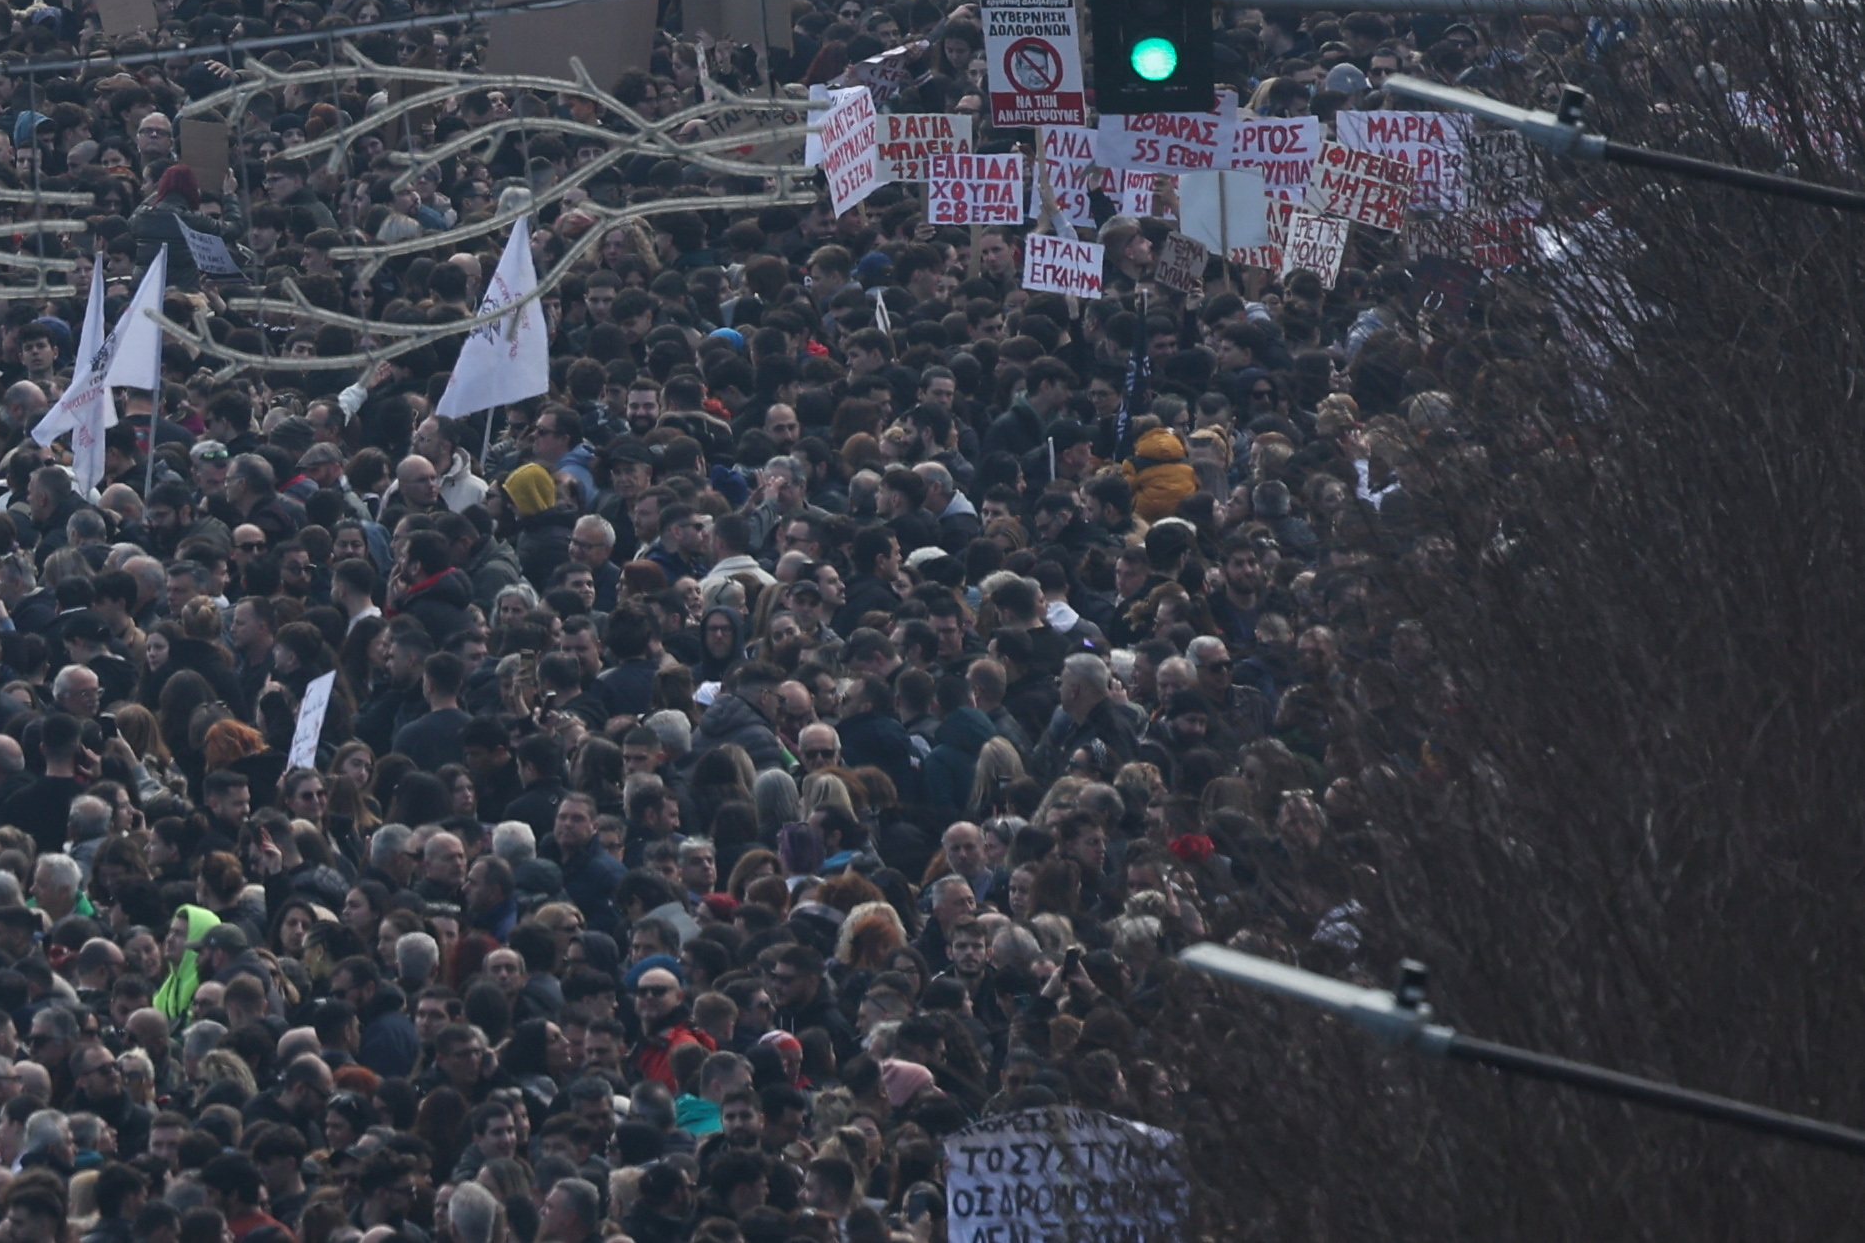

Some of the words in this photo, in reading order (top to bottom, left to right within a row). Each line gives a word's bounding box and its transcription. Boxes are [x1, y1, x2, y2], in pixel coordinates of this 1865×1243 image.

[990, 11, 1066, 24] ΚΥΒΕΡΝΗΣΗ
[988, 23, 1071, 37] ΔΟΛΟΦΟΝΩΝ
[1015, 95, 1033, 109] ΝΑ
[1034, 95, 1058, 109] ΤΗΝ
[888, 116, 954, 139] ΒΑΓΙΑ
[997, 109, 1080, 123] ΑΝΑΤΡΕΨΟΥΜΕ
[1367, 116, 1444, 144] ΜΑΡΙΑ
[1134, 138, 1161, 163] 55
[1165, 147, 1215, 169] ΕΤΩΝ
[933, 156, 1020, 180] ΕΛΠΙΔΑ
[930, 181, 1014, 204] ΧΟΥΠΑ
[936, 202, 969, 223] 28
[971, 204, 1019, 223] ΕΤΩΝ
[1029, 240, 1093, 264] ΗΤΑΝ
[1030, 261, 1103, 293] ΕΓΚΛΗΜΑ
